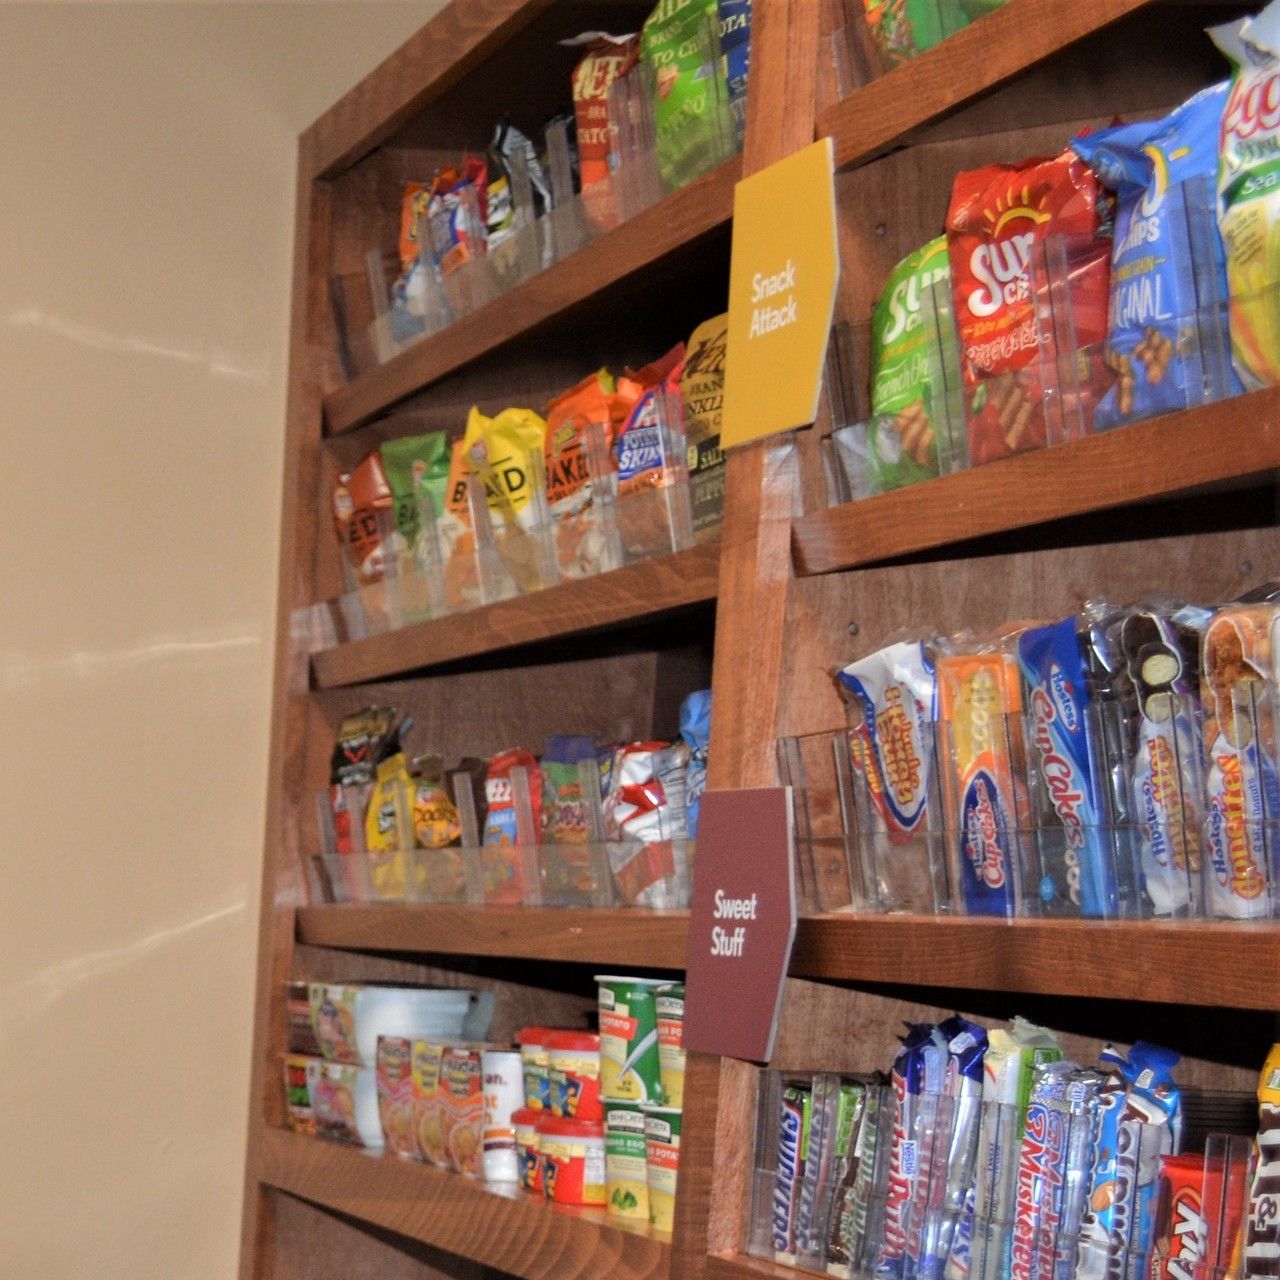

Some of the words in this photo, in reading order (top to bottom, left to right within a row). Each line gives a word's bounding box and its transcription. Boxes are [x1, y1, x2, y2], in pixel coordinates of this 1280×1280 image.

[751, 259, 796, 303] Snack
[749, 295, 798, 339] Attack
[713, 889, 757, 920] Sweet
[710, 926, 746, 957] Stuff
